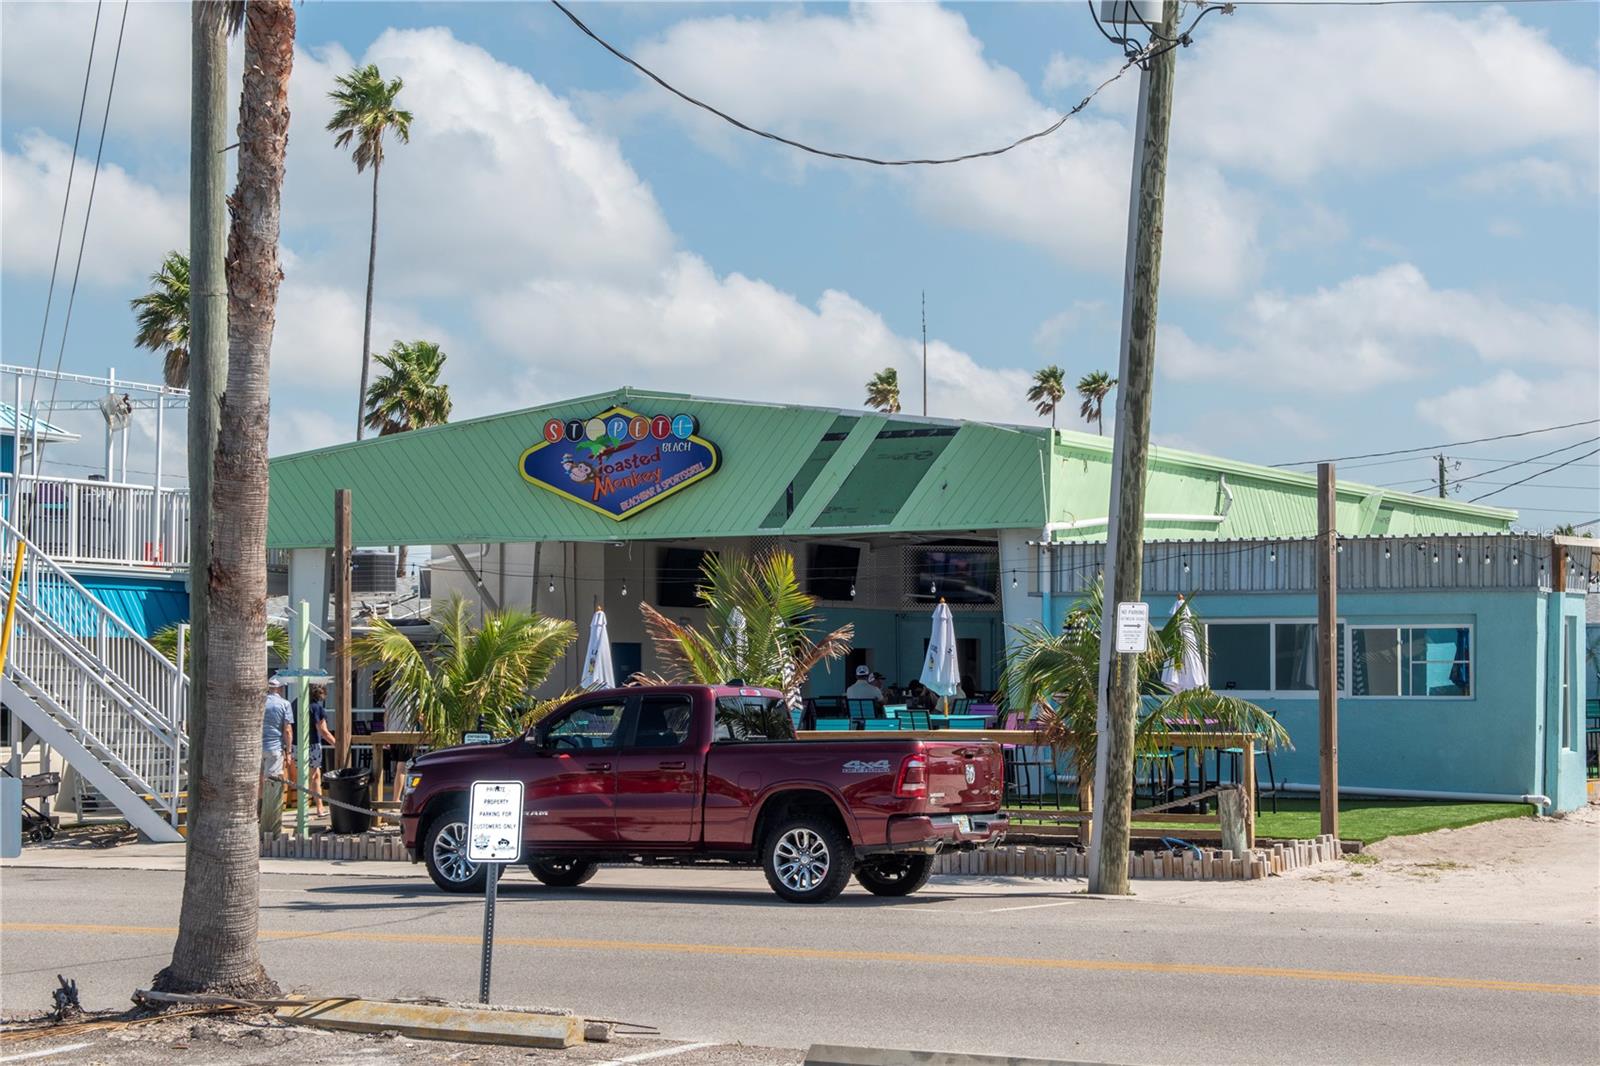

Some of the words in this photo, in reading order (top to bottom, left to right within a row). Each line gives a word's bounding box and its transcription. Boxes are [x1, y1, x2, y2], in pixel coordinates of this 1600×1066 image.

[549, 422, 580, 441] ST
[662, 441, 692, 452] BEACH
[592, 445, 662, 476] Toasted
[591, 468, 662, 501] Monkey
